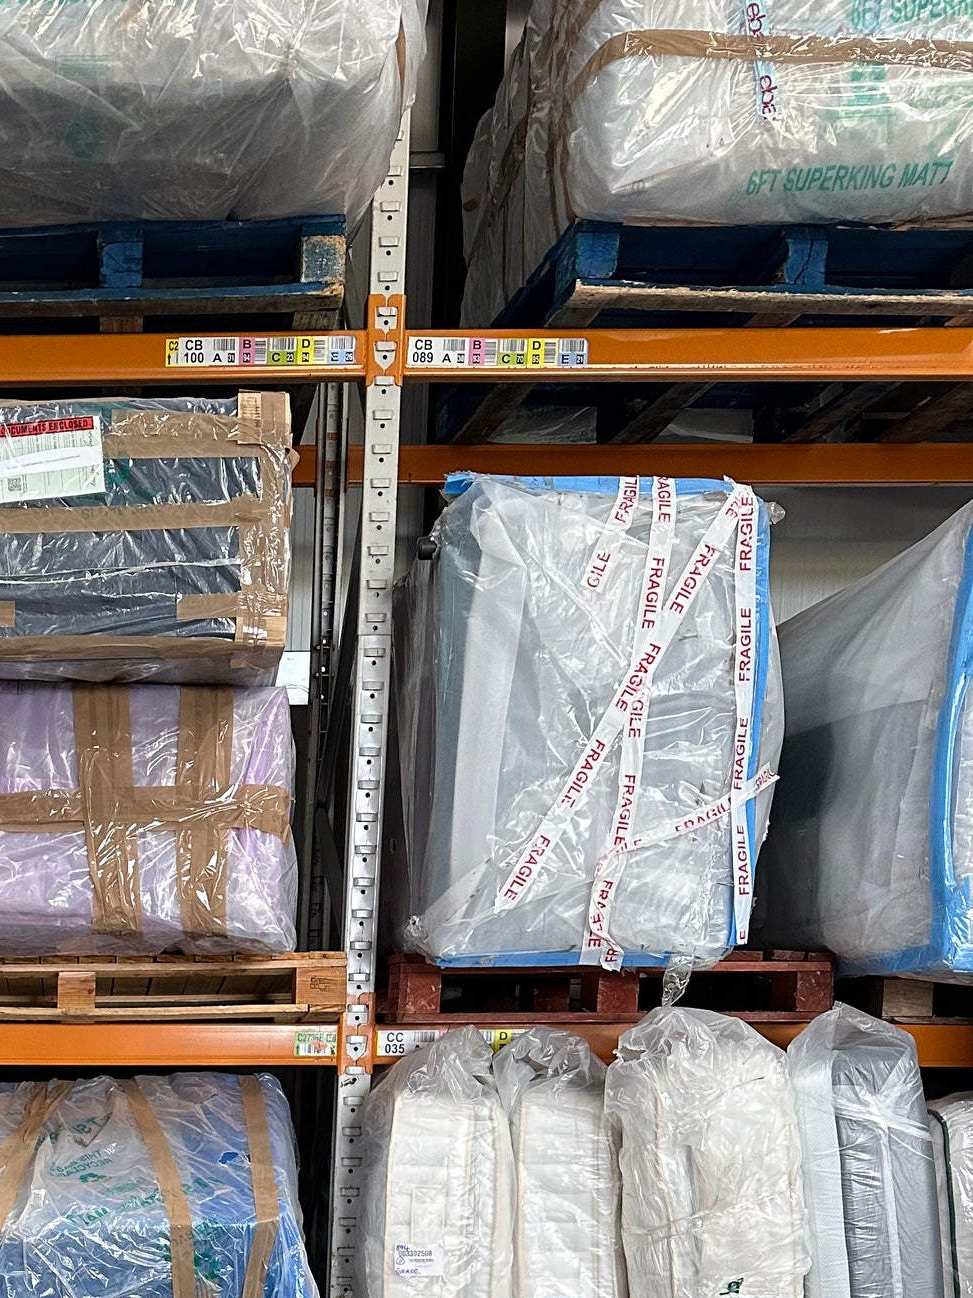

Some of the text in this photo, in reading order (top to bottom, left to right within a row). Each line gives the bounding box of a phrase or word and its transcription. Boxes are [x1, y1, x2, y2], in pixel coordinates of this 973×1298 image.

[746, 160, 954, 195] 6FT SUPERKING MATT
[185, 340, 203, 350] CB
[243, 340, 251, 348] B
[302, 340, 310, 348] D
[415, 340, 433, 350] CB
[473, 341, 481, 349] B
[533, 341, 541, 350] D
[183, 353, 204, 362] 100
[213, 354, 222, 362] A
[271, 353, 280, 362] C
[413, 352, 433, 363] 089
[442, 354, 451, 362] A
[501, 354, 510, 363] C
[561, 355, 569, 364] E
[49, 419, 88, 431] ENCLOSED
[658, 476, 671, 522] RAGILE
[740, 496, 753, 571] FRAGILE
[670, 544, 716, 614] FRAGILE
[642, 558, 665, 629] FRAGILE
[739, 608, 751, 682] FRAGILE
[615, 642, 661, 712] FRAGILE
[733, 718, 749, 790] FRAGILE
[561, 739, 605, 808] FRAGILE
[614, 774, 635, 846] FRAGILE
[737, 825, 750, 896] FRAGILE
[503, 835, 551, 901] FRAGILE
[387, 1032, 403, 1042] CC
[499, 1032, 507, 1040] D
[385, 1044, 405, 1053] 035
